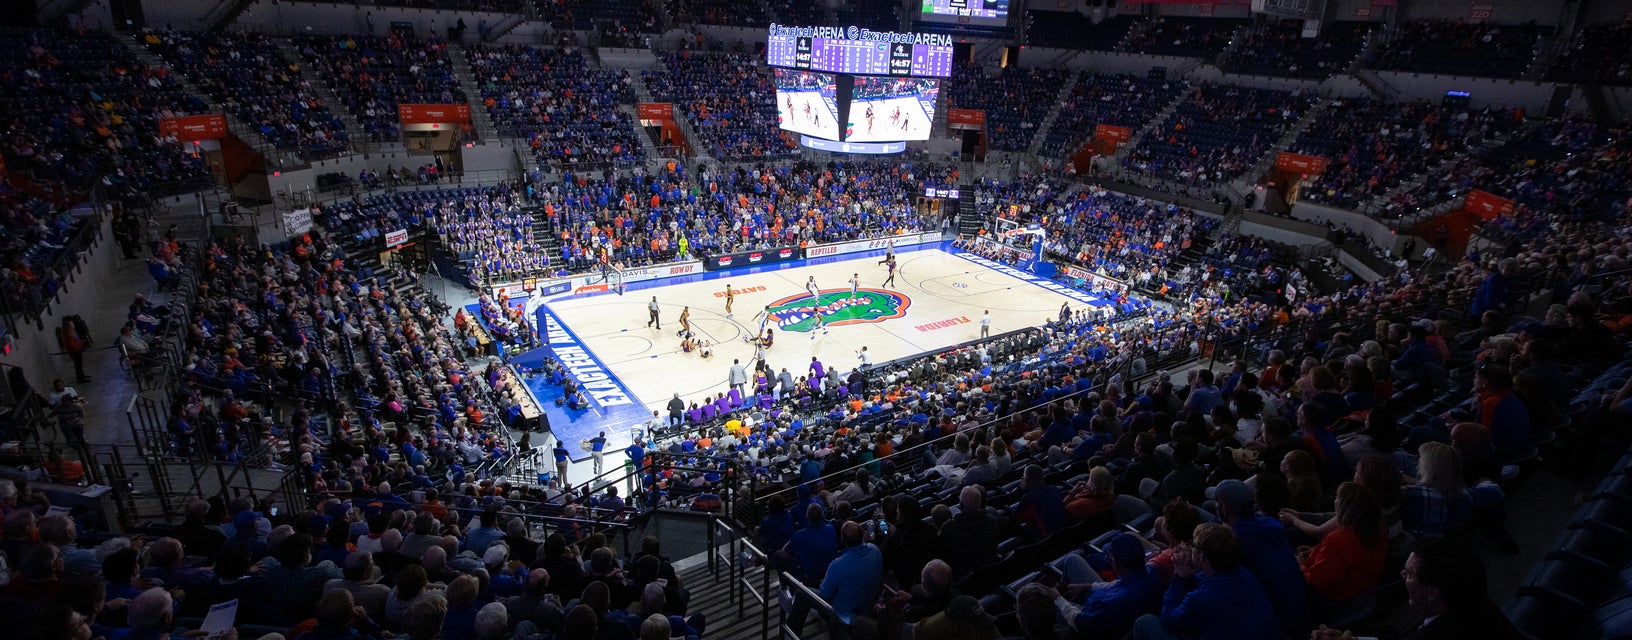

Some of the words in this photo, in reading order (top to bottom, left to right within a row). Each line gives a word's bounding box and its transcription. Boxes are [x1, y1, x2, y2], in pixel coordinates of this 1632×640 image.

[813, 26, 845, 39] ARENA
[860, 29, 914, 44] Exactech
[914, 33, 953, 46] ARENA
[891, 59, 911, 67] 14:57
[387, 232, 407, 244] ESPN
[810, 246, 838, 257] REPTILES
[622, 269, 648, 278] DAVIS
[669, 264, 694, 275] ROWDY
[1070, 269, 1095, 282] FLORIDA
[914, 316, 972, 332] FLORIDA
[551, 345, 634, 407] EXACTECH
